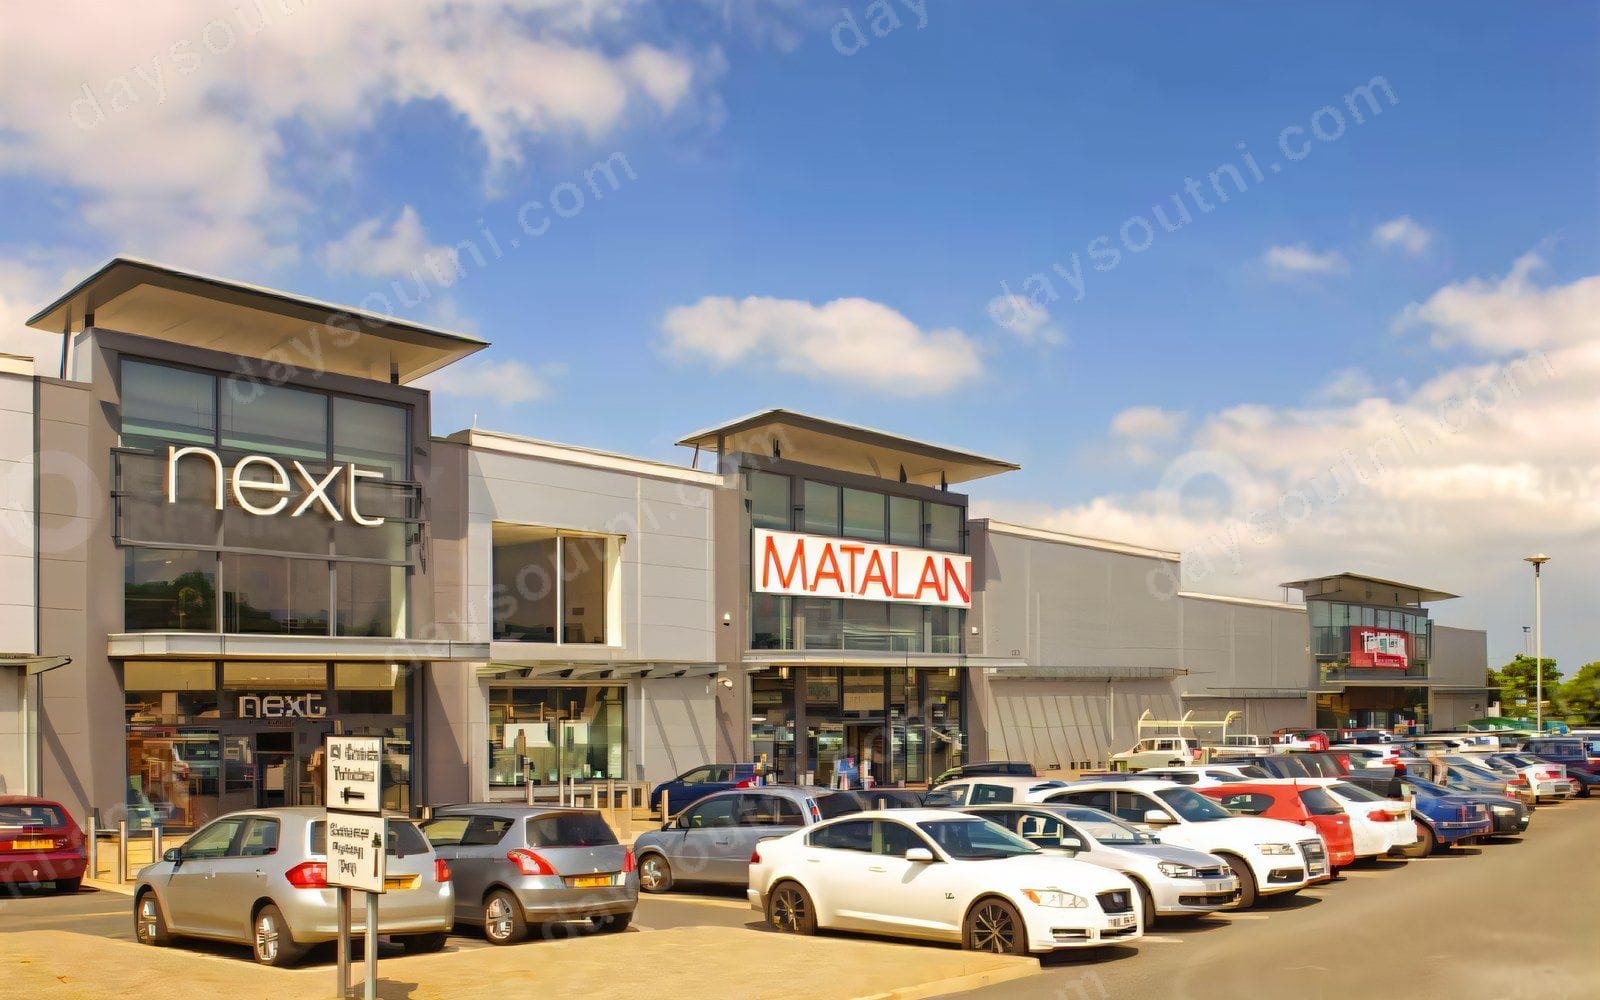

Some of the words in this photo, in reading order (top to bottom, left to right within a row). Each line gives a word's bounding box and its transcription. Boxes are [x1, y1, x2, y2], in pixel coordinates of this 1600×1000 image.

[168, 445, 385, 526] next
[763, 536, 972, 603] MATALAN
[238, 693, 327, 718] next
